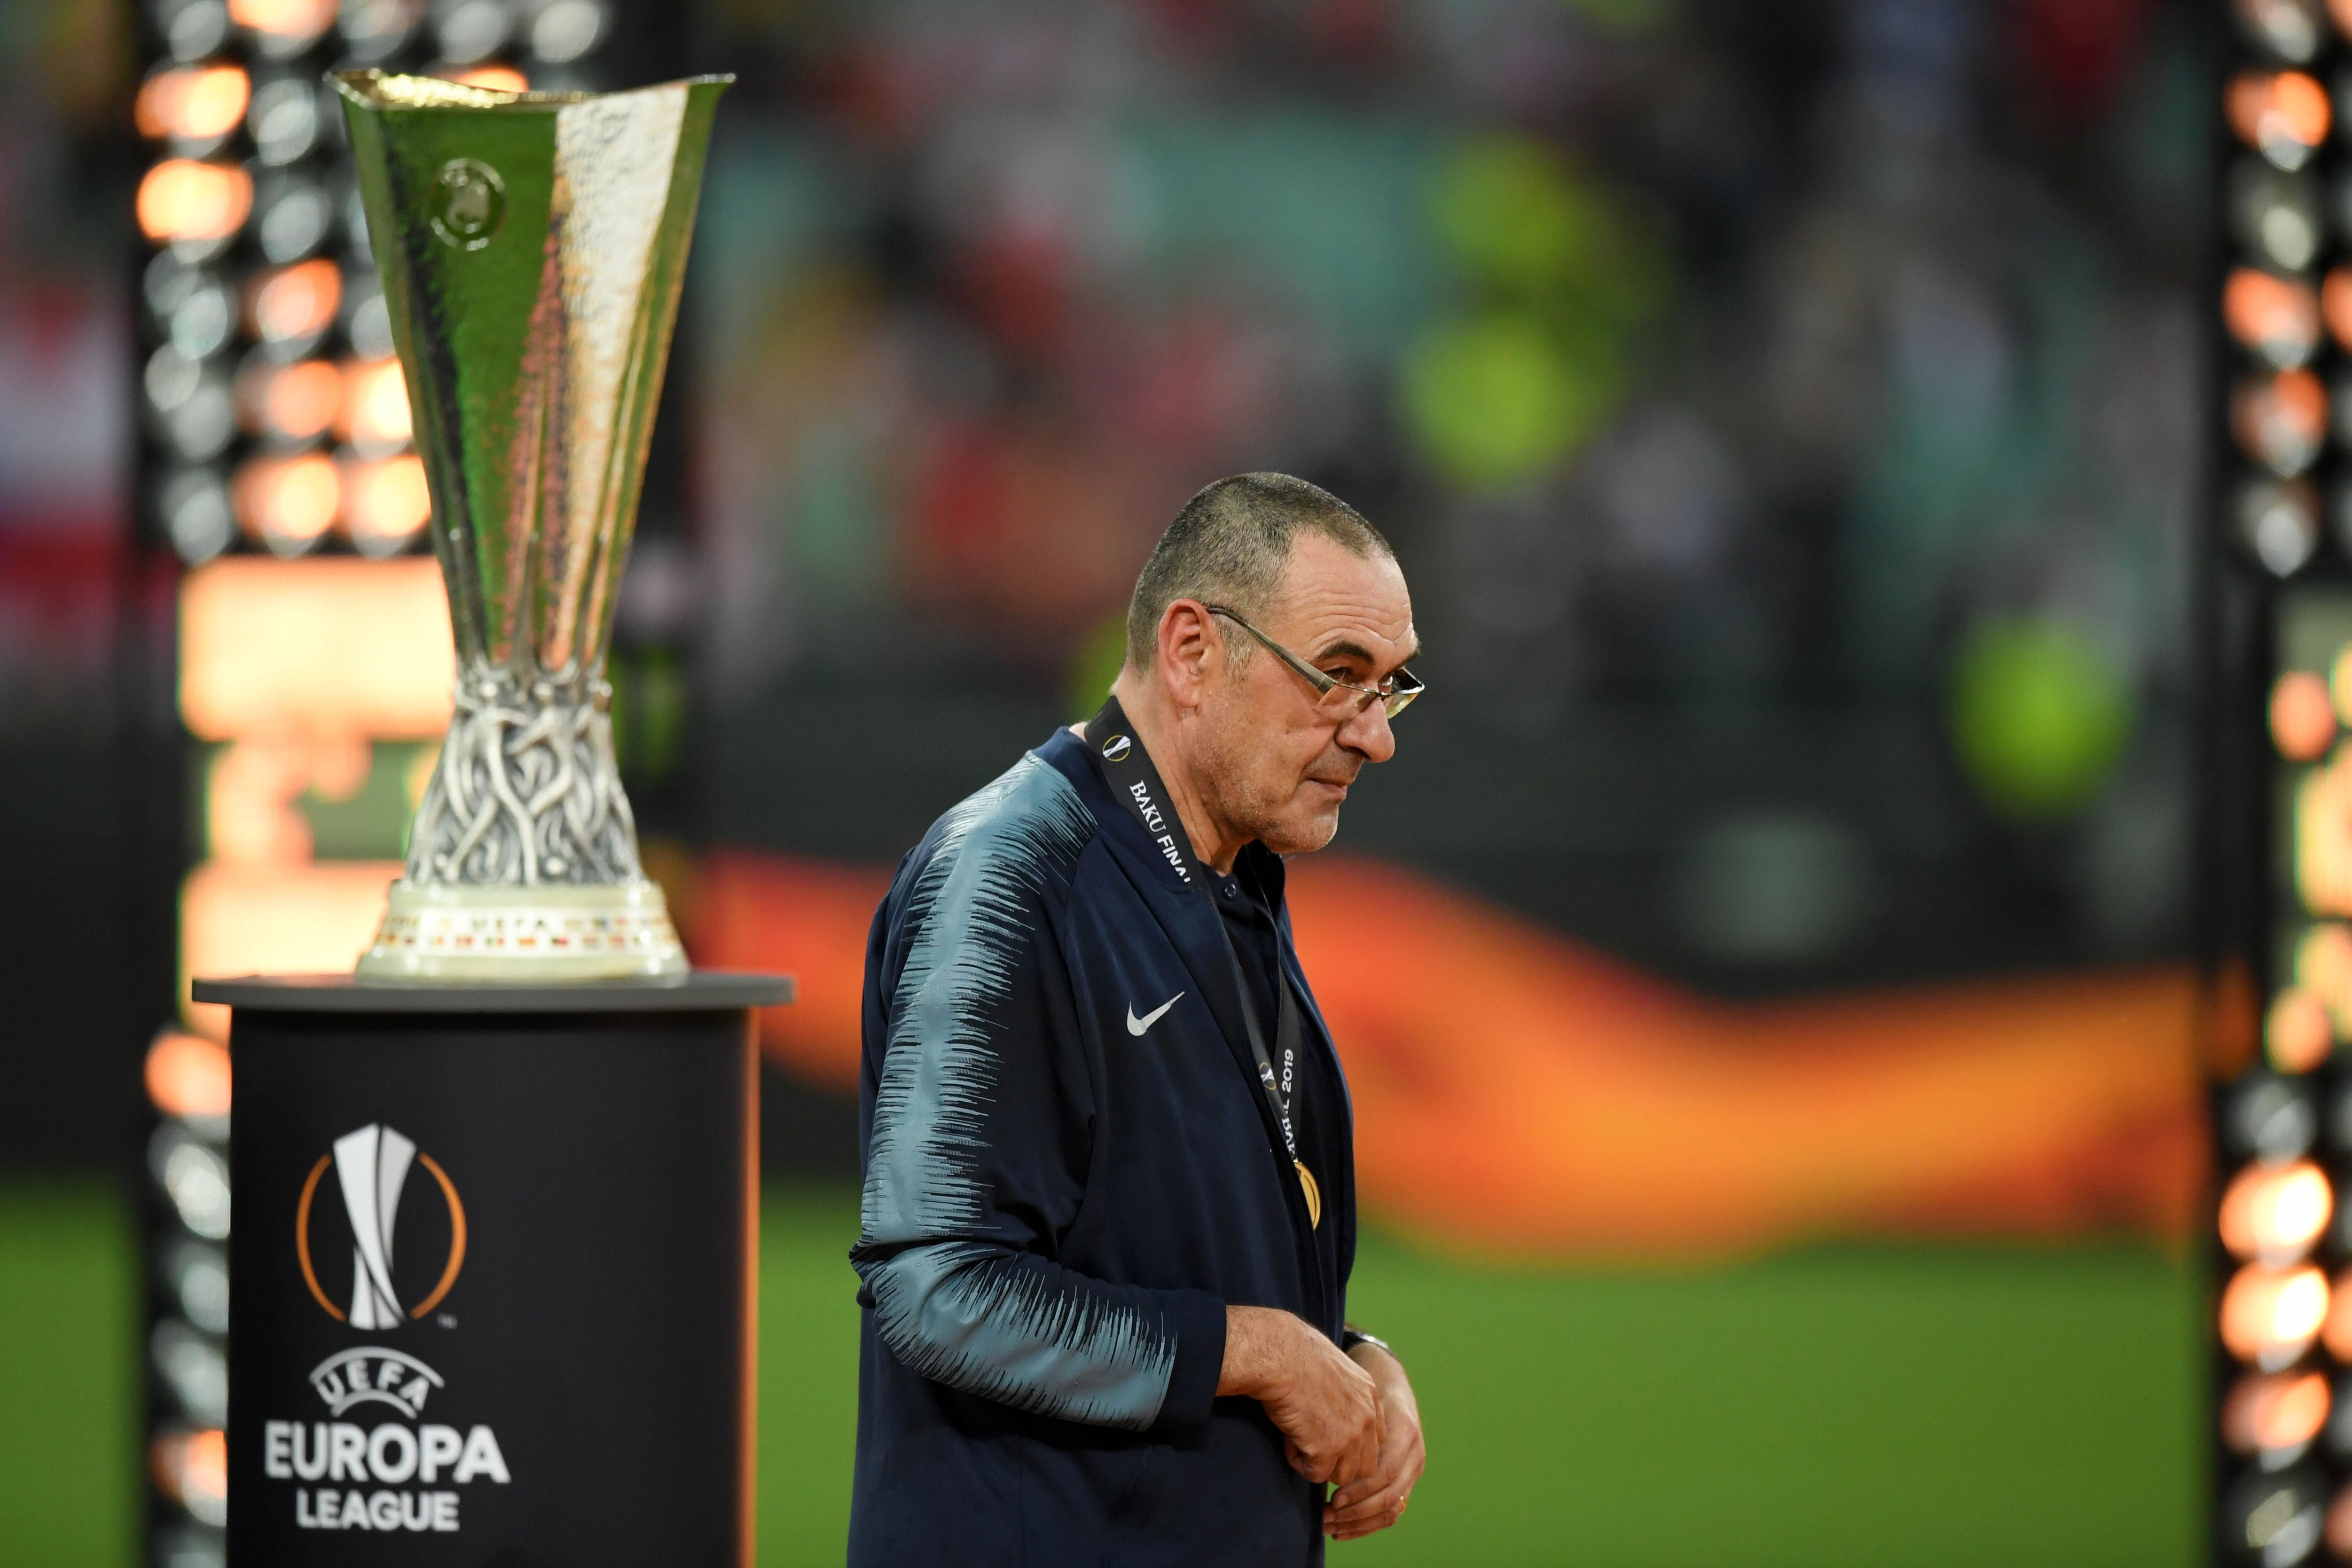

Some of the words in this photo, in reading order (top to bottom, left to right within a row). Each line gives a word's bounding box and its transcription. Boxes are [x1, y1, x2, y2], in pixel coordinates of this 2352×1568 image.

[1129, 780, 1167, 832] BAKU
[1282, 1049, 1294, 1093] 2019
[314, 1356, 430, 1411] UEFA
[265, 1419, 511, 1483] EUROPA
[296, 1488, 460, 1532] LEAGUE
